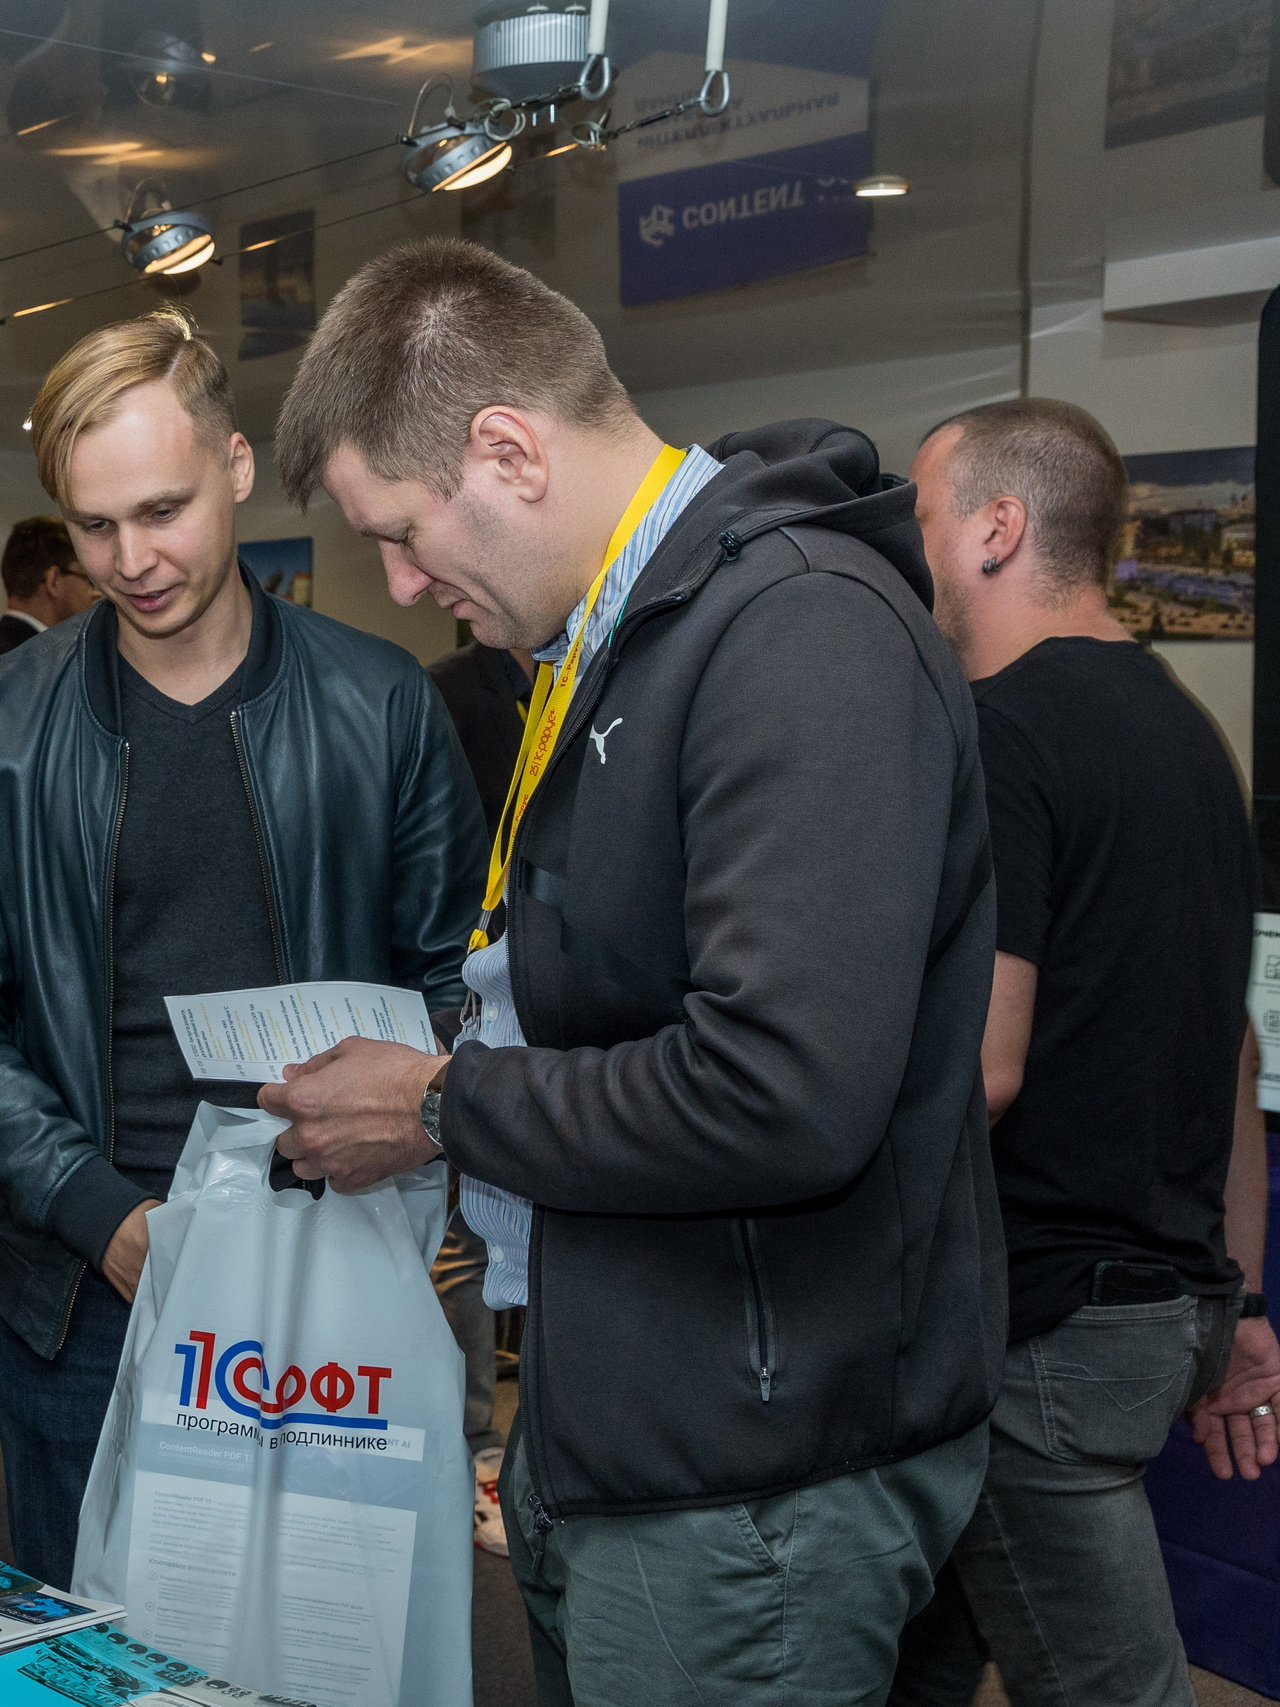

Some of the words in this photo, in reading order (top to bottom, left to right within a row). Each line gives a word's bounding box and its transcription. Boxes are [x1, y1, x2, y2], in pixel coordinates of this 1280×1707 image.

[280, 1430, 388, 1451] подлиннике
[159, 1441, 222, 1460] ContentReader
[224, 1451, 242, 1461] PDF
